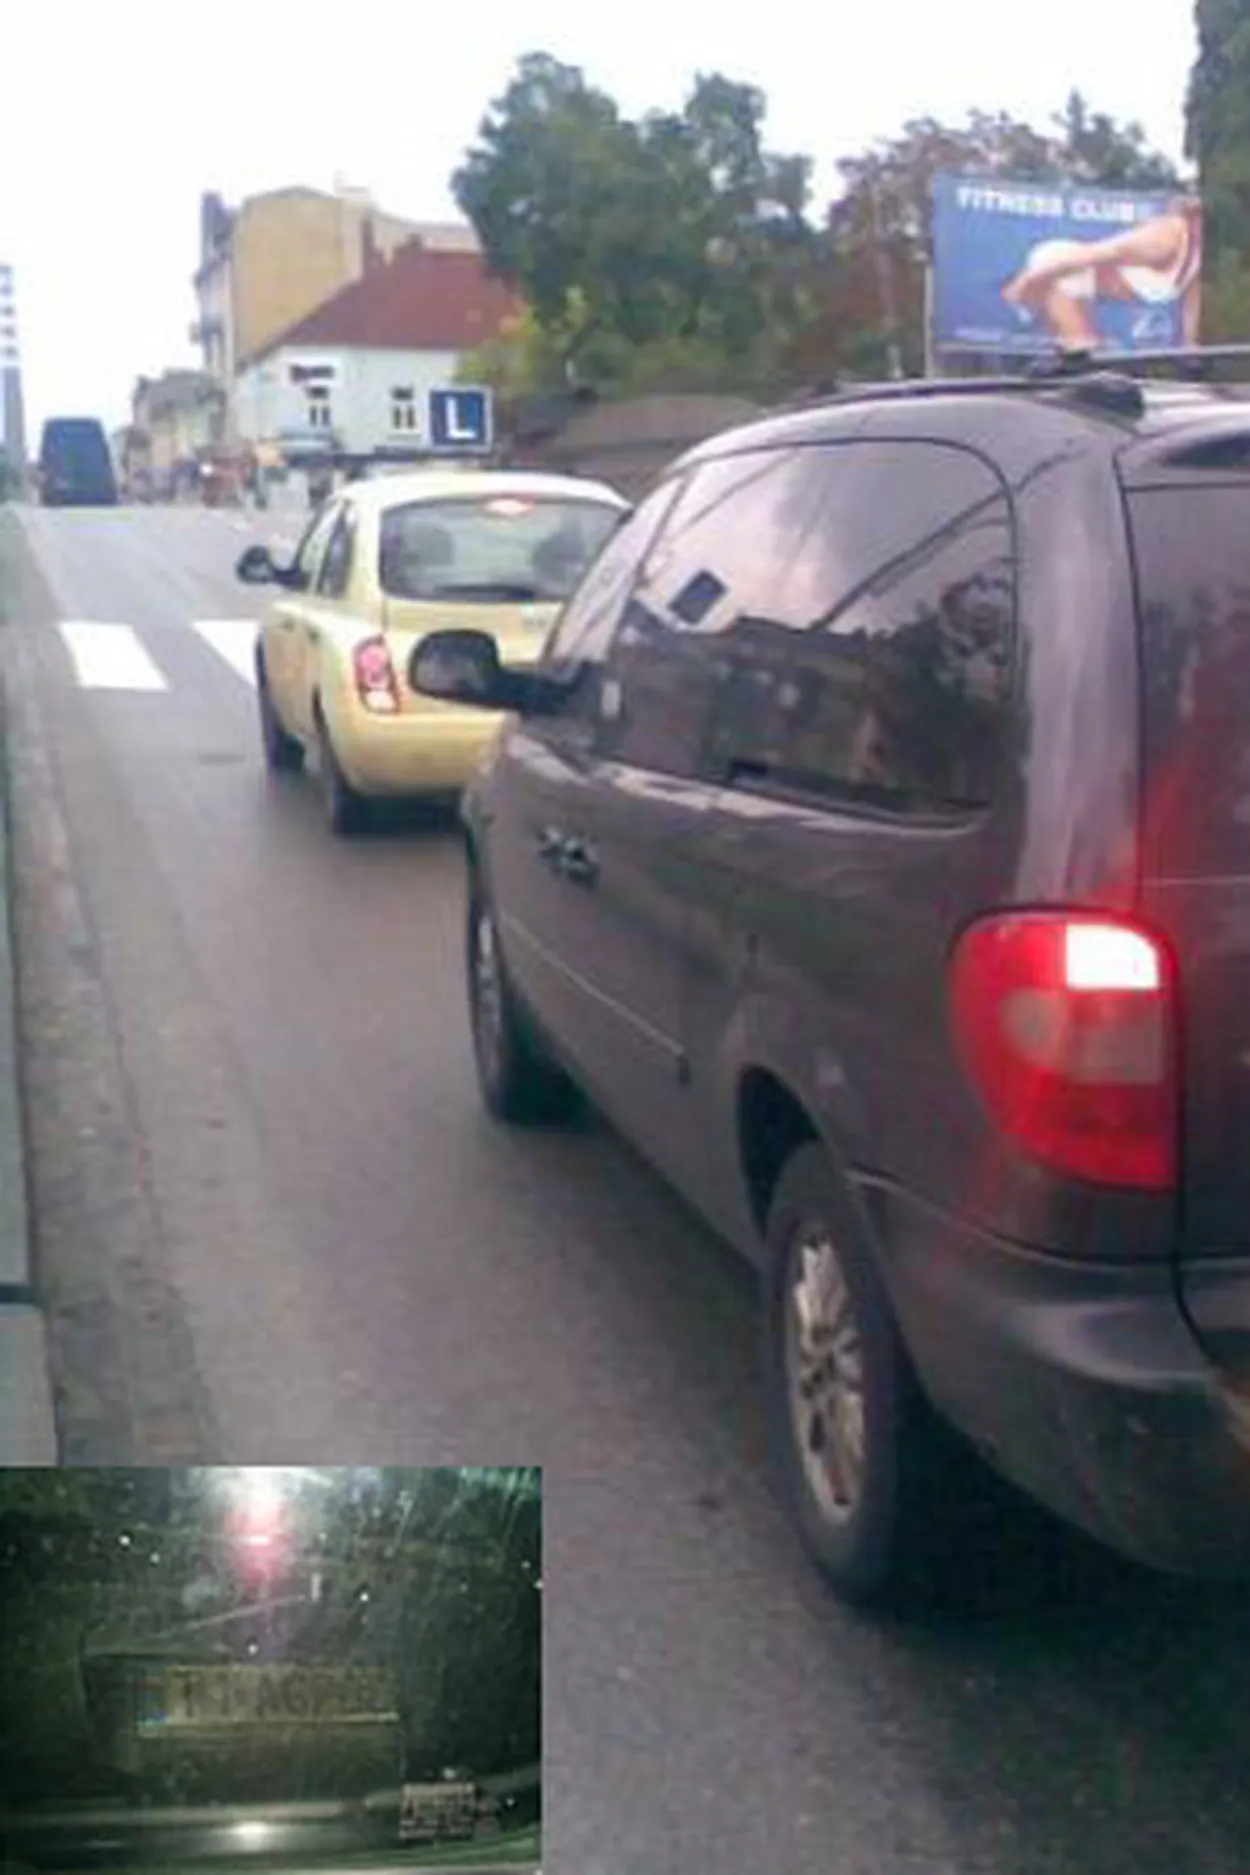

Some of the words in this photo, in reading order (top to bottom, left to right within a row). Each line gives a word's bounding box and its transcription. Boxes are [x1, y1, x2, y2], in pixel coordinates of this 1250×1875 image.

[957, 186, 1062, 215] FITNESS
[1069, 198, 1134, 221] CLUB
[446, 396, 477, 440] L
